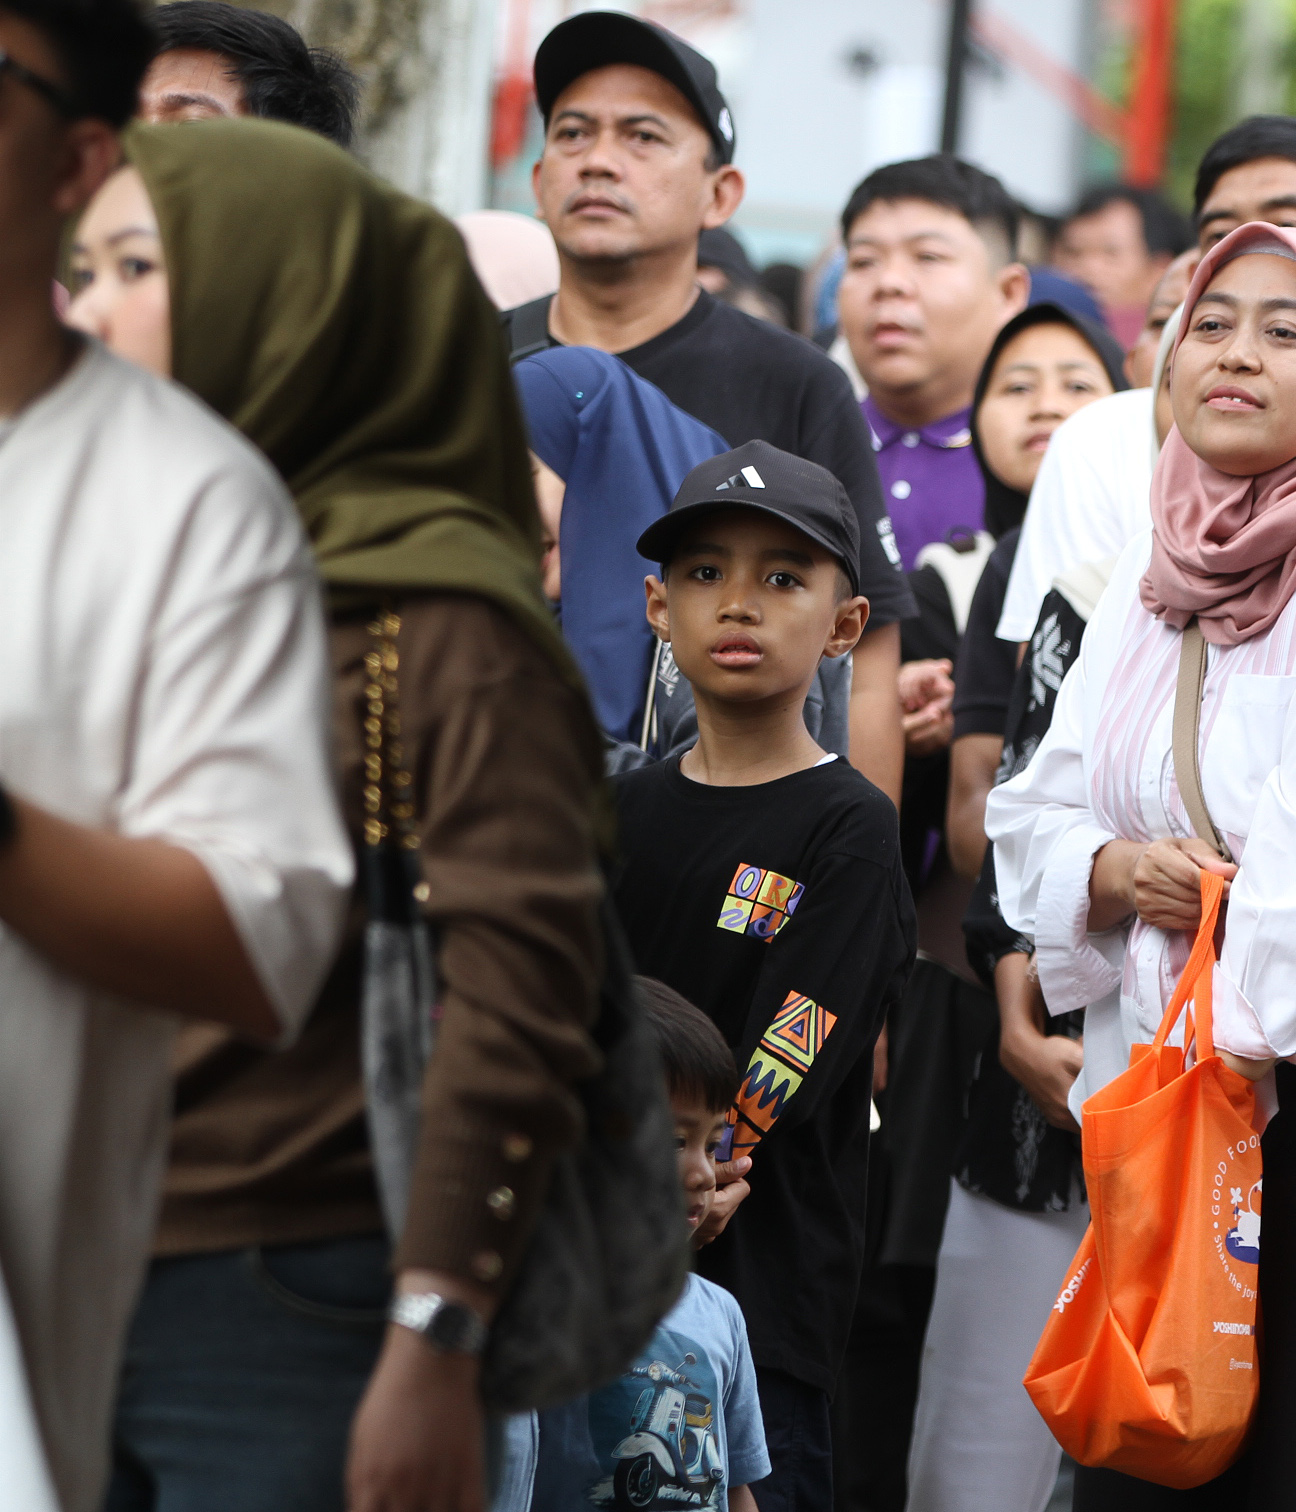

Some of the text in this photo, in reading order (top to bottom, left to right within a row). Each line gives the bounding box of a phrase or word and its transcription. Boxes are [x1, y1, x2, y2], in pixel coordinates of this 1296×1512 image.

[1211, 1161, 1227, 1216] GOOD
[1214, 1234, 1230, 1273] Share
[1228, 1272, 1242, 1292] the
